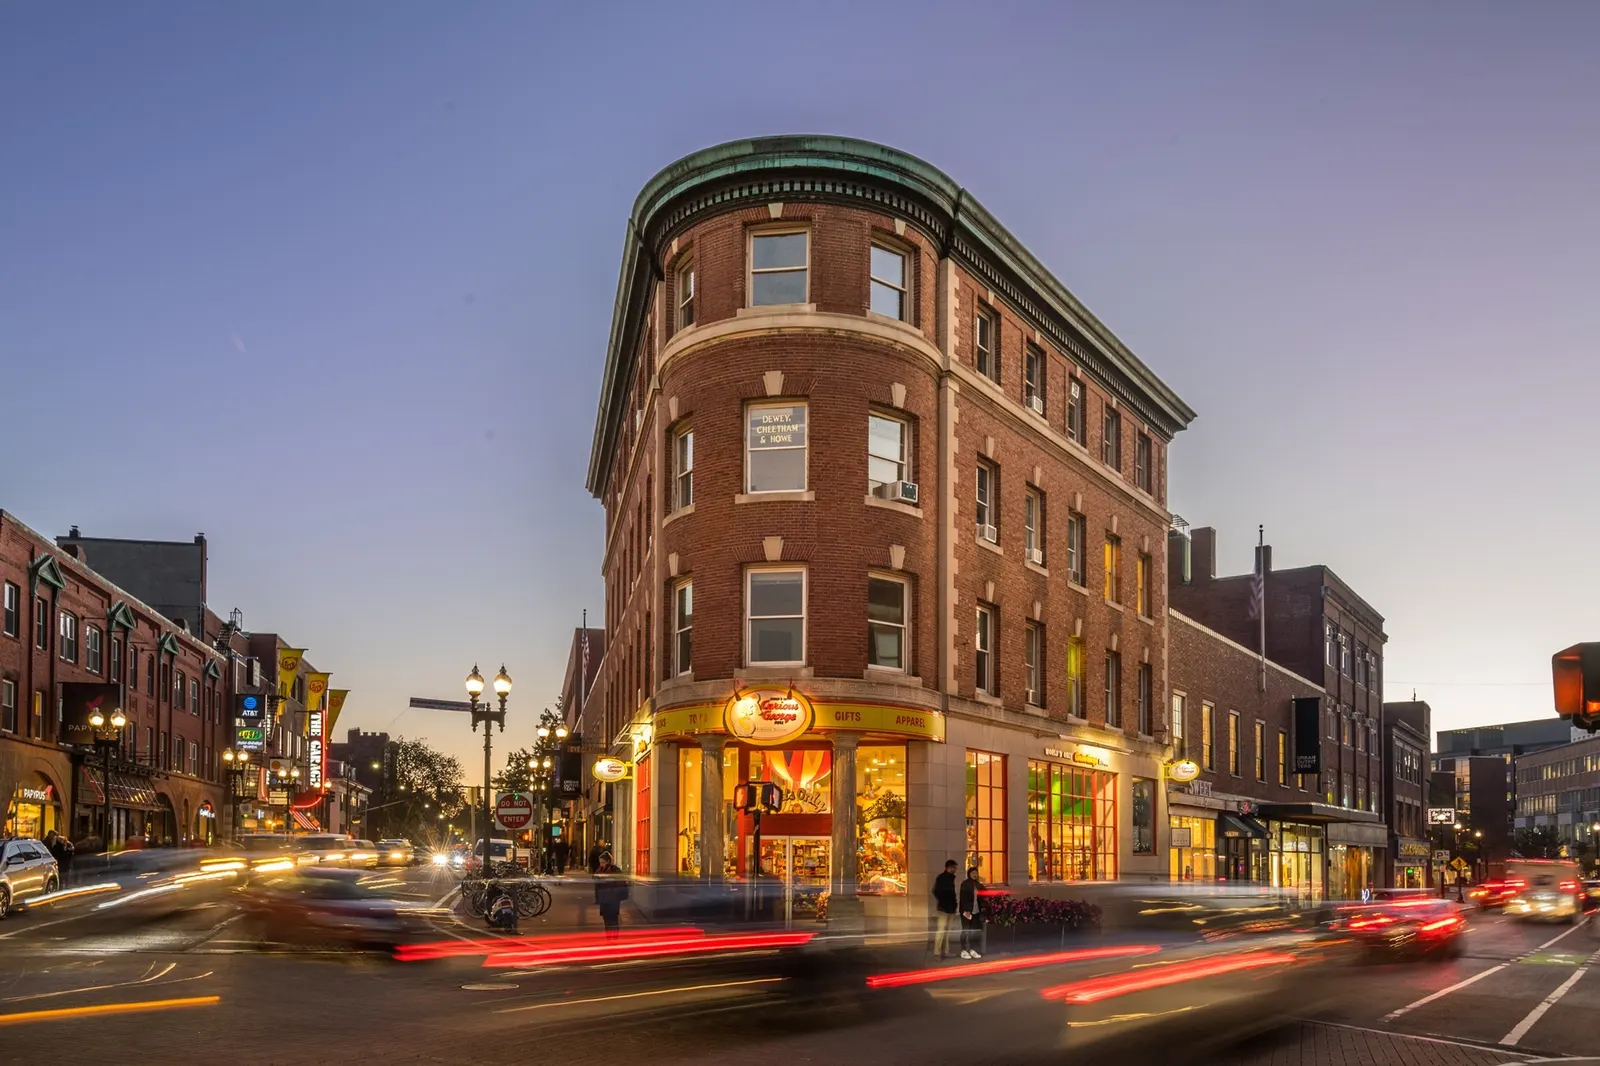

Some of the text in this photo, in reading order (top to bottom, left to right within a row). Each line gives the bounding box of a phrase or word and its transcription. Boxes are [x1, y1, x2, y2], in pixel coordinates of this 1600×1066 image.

[756, 424, 798, 434] CHEETHAM
[770, 434, 792, 443] HOWE
[310, 711, 321, 736] THE
[834, 711, 926, 728] GIFTS APPAREL
[68, 724, 114, 733] PAPYUS
[23, 788, 46, 800] PAPYRUS
[1188, 779, 1212, 798] SWEET
[503, 815, 525, 823] ENTER
